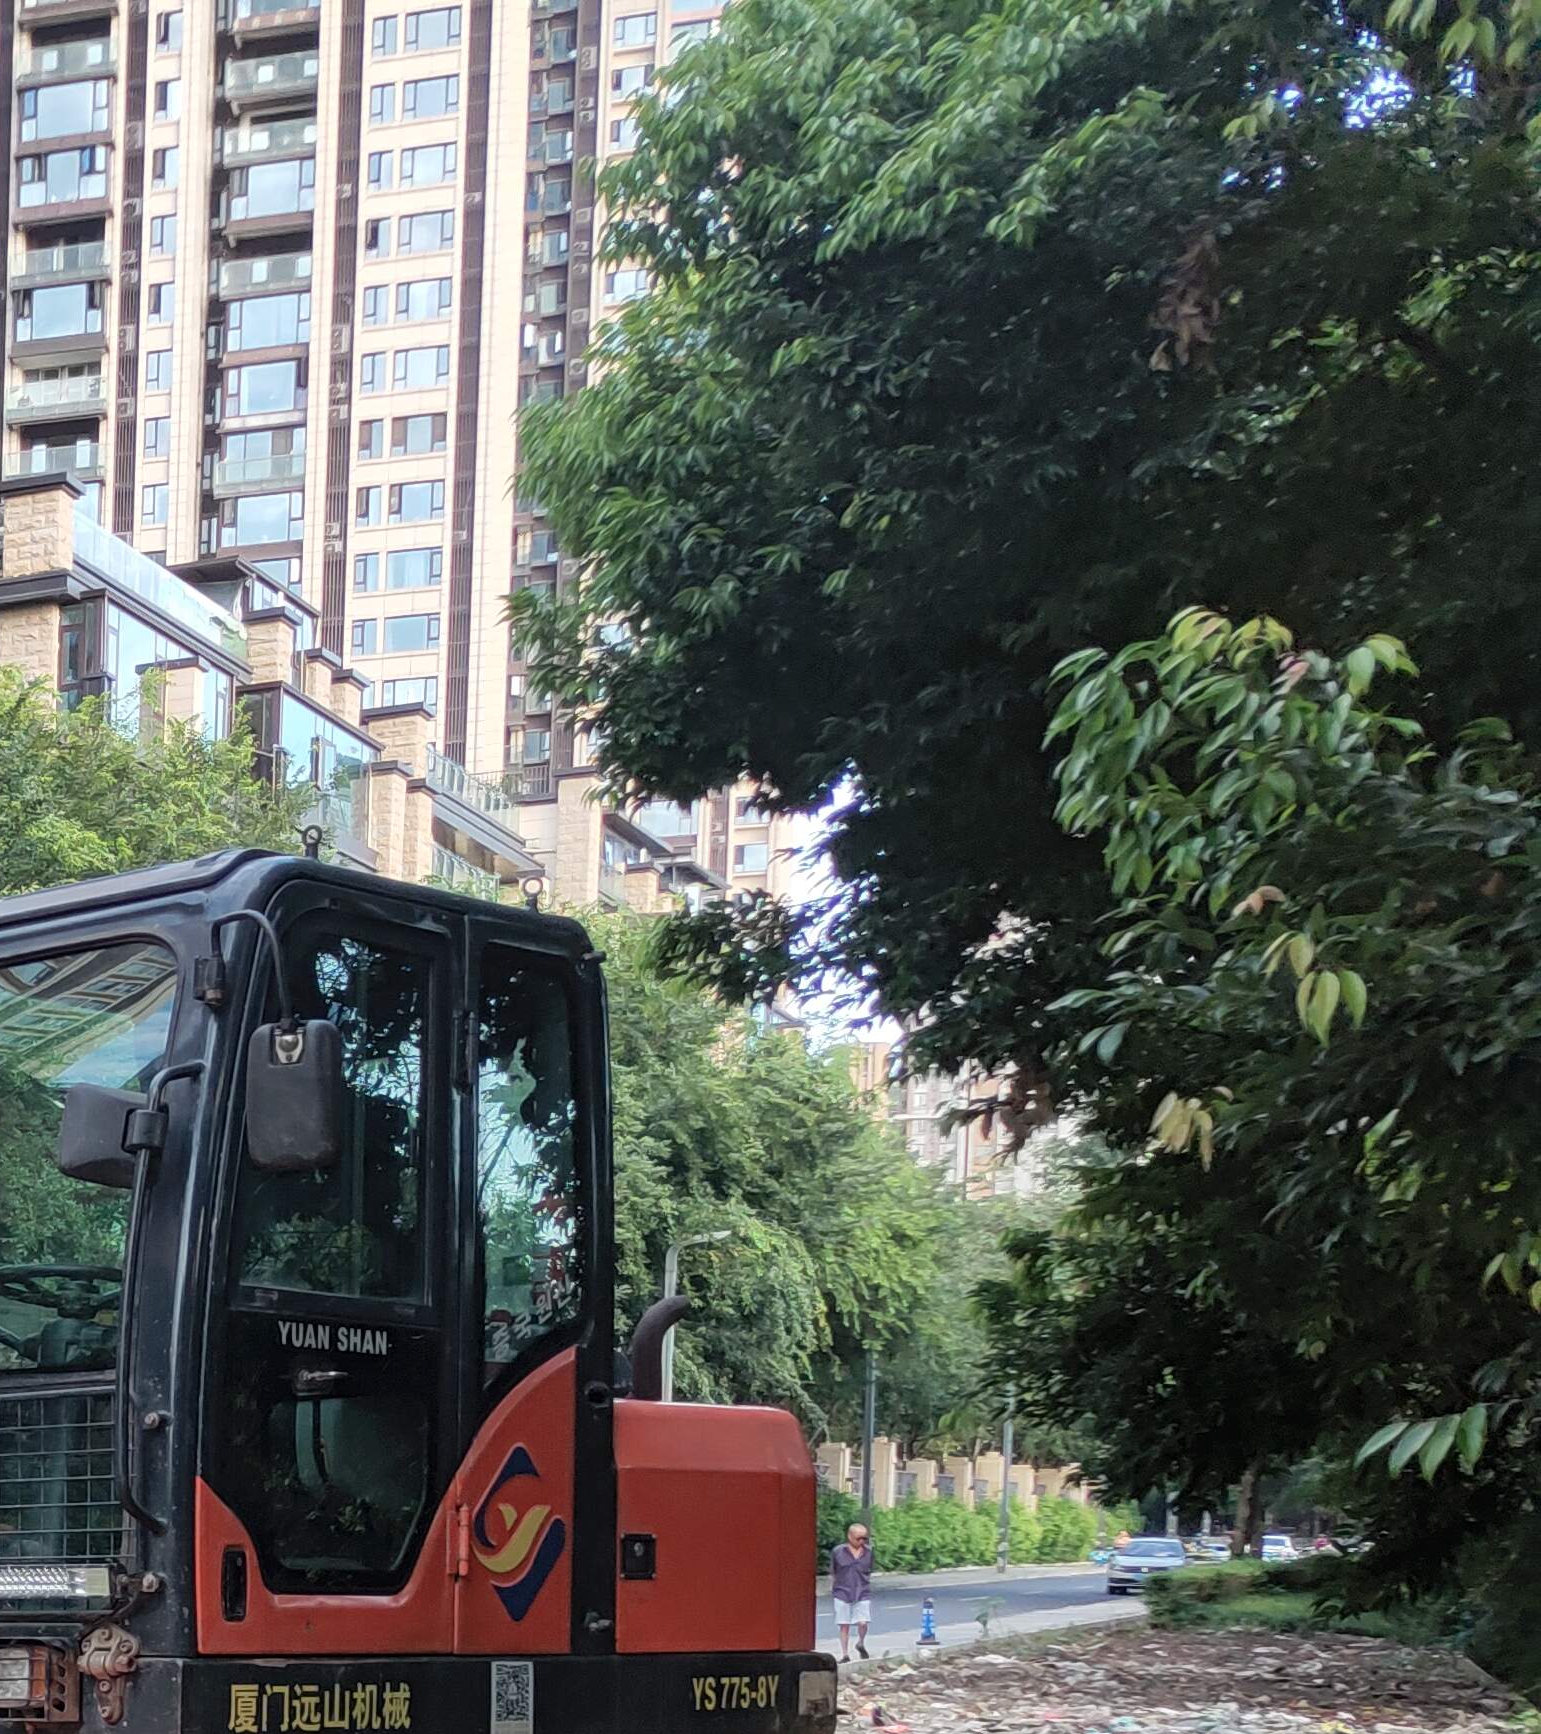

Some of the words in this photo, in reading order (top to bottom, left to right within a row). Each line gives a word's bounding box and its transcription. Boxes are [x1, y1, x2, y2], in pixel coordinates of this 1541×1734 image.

[278, 1320, 330, 1350] YUAN
[337, 1326, 387, 1356] SHAN
[228, 1682, 411, 1733] 厦门远山机械
